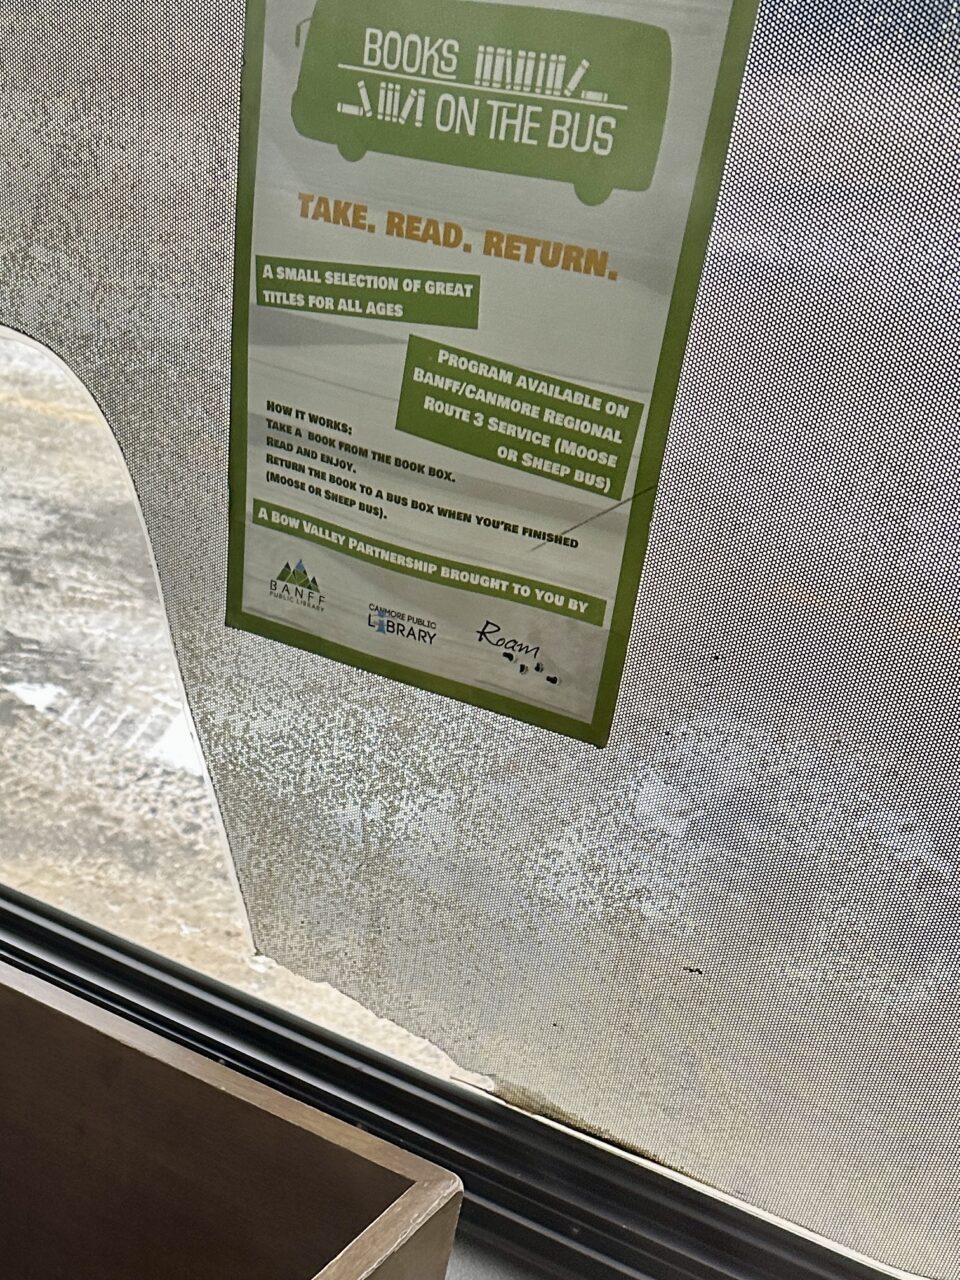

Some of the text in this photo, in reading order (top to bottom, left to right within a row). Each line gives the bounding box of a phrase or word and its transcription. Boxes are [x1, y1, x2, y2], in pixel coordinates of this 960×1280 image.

[363, 27, 459, 79] BOOKS
[436, 93, 616, 156] ON THE BUS
[298, 192, 618, 281] TAKE. READ. RETURN.
[263, 264, 473, 297] A SMALL SELECTION OF GREAT
[263, 290, 403, 317] TITLES FOR ALL AGES
[413, 367, 622, 444] BANFF/CANMORE REGIONAL
[438, 349, 629, 419] PROGRAM AVAILABLE ON
[266, 400, 352, 435] HOW IT WORKS:
[424, 395, 618, 468] ROUTE 3 SERVICE (MOOSE
[266, 418, 456, 482] TAKE A BOOK FROM THE BOOK BOX.
[266, 436, 356, 473] READ AND ENJOY.
[497, 446, 611, 493] OR SHEEP BUS)
[266, 471, 388, 519] (MOOSE OR SHEEP BUS).
[266, 454, 579, 549] RETURN THE BOOK TO A BUS BOX WHEN YOU'RE FINISHED
[258, 508, 588, 613] A BOW VALLEY PARTNERSHIP BROUGHT TO YOU BY
[269, 591, 324, 612] PUBLIC LIBRARY
[270, 579, 326, 605] BANFF
[368, 603, 437, 629] CANMORE PUBLIC
[476, 620, 540, 658] Roam
